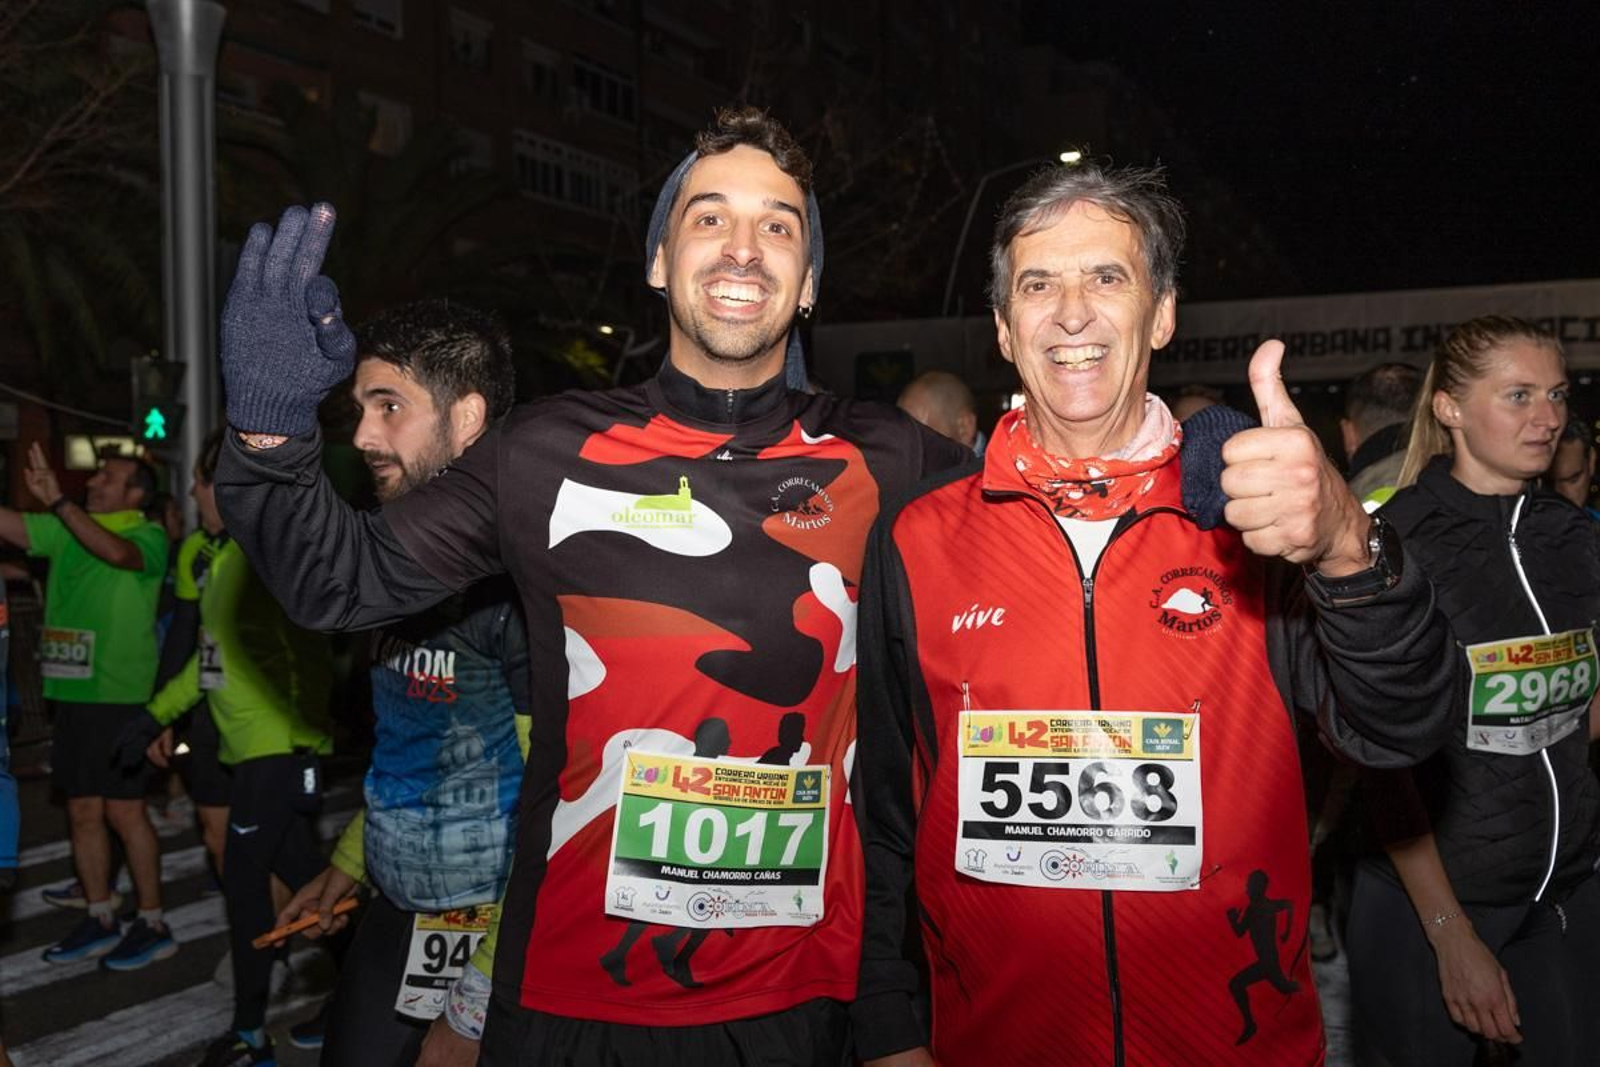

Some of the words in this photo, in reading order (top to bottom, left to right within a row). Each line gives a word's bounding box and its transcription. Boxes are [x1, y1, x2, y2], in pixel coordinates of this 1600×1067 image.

[1157, 332, 1267, 363] RRERA
[1281, 326, 1391, 355] RBANA
[611, 506, 697, 525] oleomar
[783, 511, 832, 530] Martos
[1157, 609, 1222, 633] Martos
[384, 640, 456, 685] NTON
[1506, 643, 1534, 665] 42
[1484, 661, 1590, 714] 2968
[1008, 719, 1049, 748] 42
[1050, 735, 1078, 748] SAN
[672, 765, 713, 796] 42
[714, 767, 756, 779] CARRERA
[712, 783, 741, 797] SAN
[743, 786, 788, 801] ANTON
[980, 762, 1178, 822] 5568
[639, 802, 814, 865] 1017
[1004, 825, 1044, 836] MANUEL
[1047, 826, 1104, 838] CHAMORRO
[1106, 827, 1152, 839] GARRIDO
[661, 865, 699, 879] MANUEL
[702, 870, 753, 880] CHAMORRO
[754, 871, 781, 880] CAÑAS
[422, 933, 486, 974] 94
